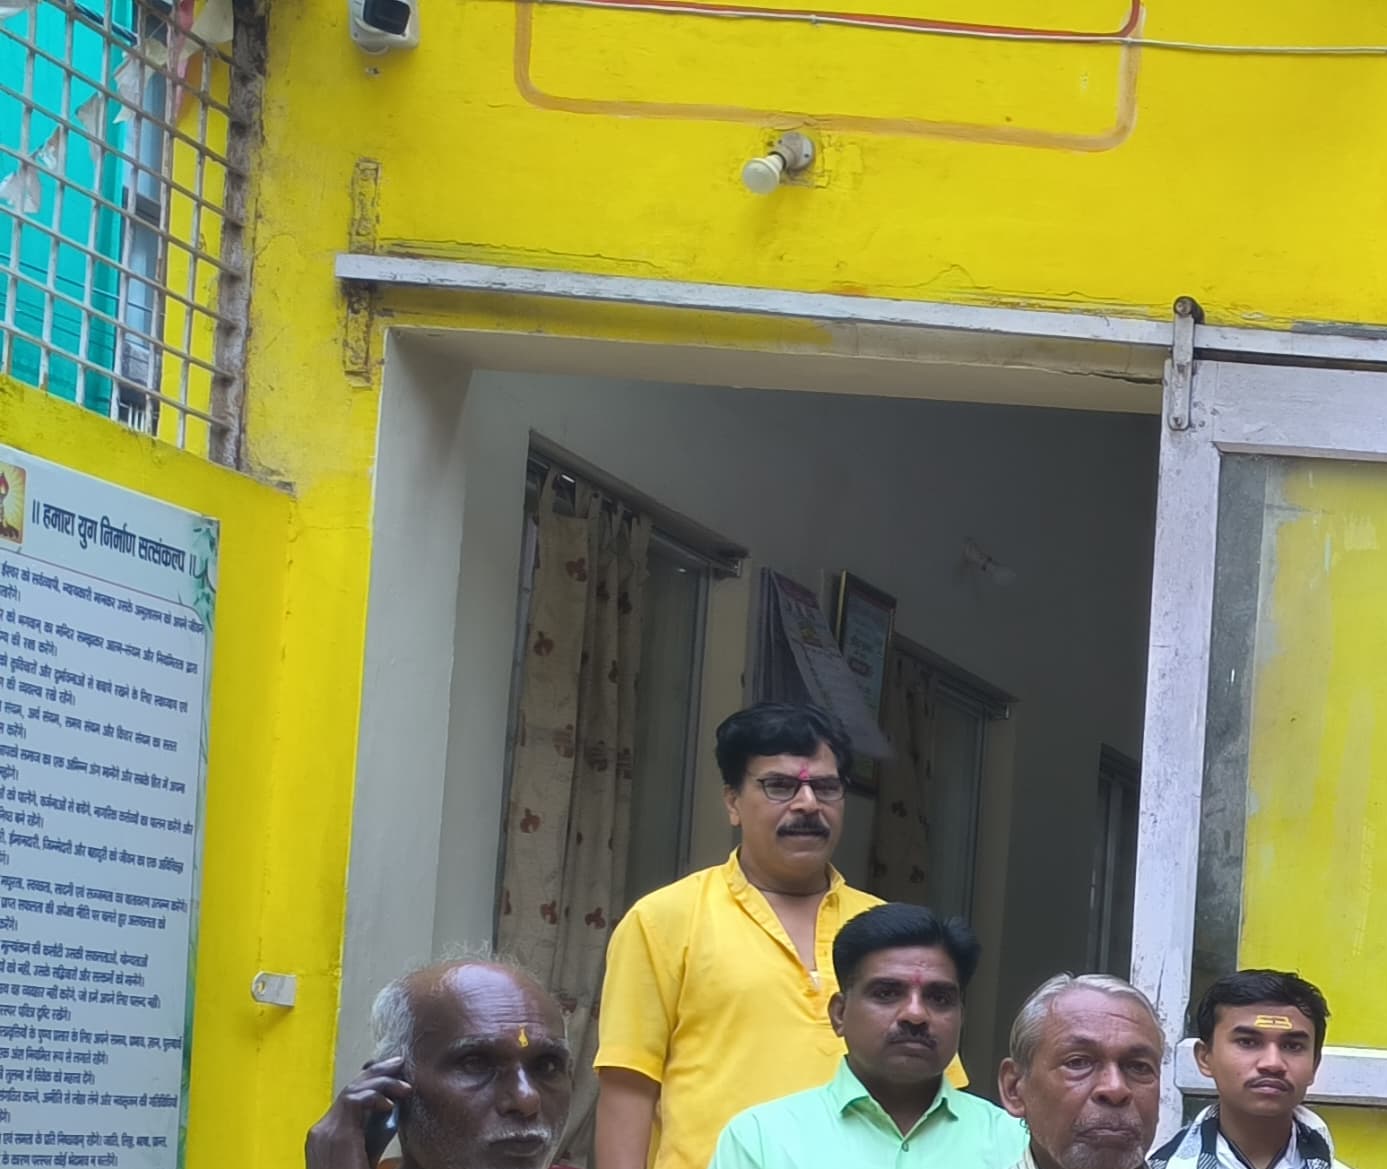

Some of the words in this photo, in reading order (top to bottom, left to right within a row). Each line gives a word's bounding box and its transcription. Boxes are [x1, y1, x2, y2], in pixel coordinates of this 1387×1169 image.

[43, 503, 76, 536] हमारा
[78, 515, 98, 550] युग
[100, 515, 136, 557] निर्माण
